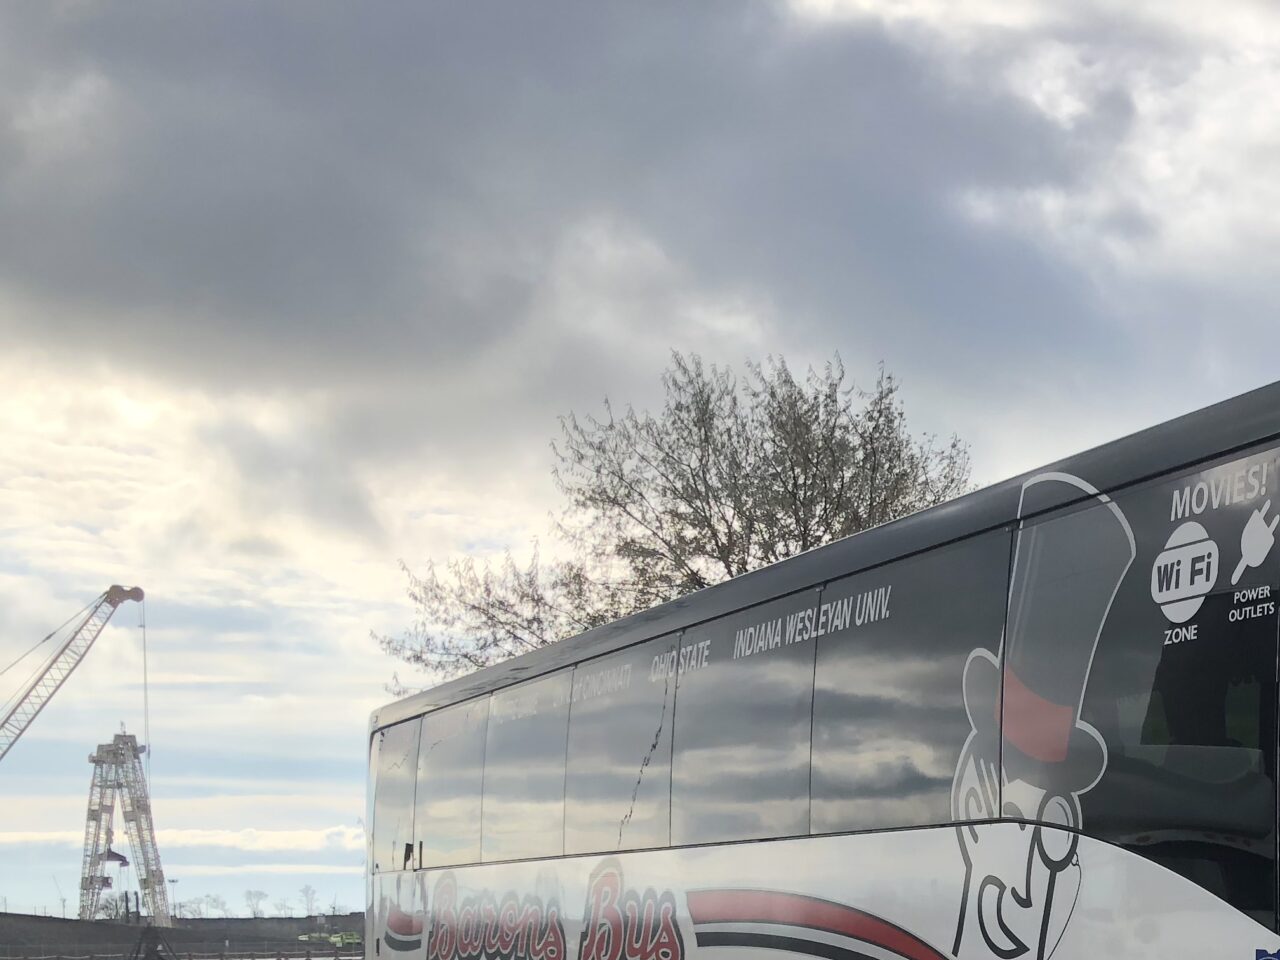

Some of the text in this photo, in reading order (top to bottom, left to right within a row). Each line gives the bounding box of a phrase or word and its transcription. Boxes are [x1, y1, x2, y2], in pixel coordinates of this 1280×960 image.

[1171, 463, 1268, 521] MOVIES!
[1157, 552, 1212, 592] Wi Fi
[1228, 602, 1275, 622] OUTLETS
[1233, 586, 1271, 604] POWER
[734, 585, 891, 659] INDIANA WESLEYAN UNIV.
[1164, 625, 1198, 645] ZONE
[651, 640, 711, 682] OHIO STATE
